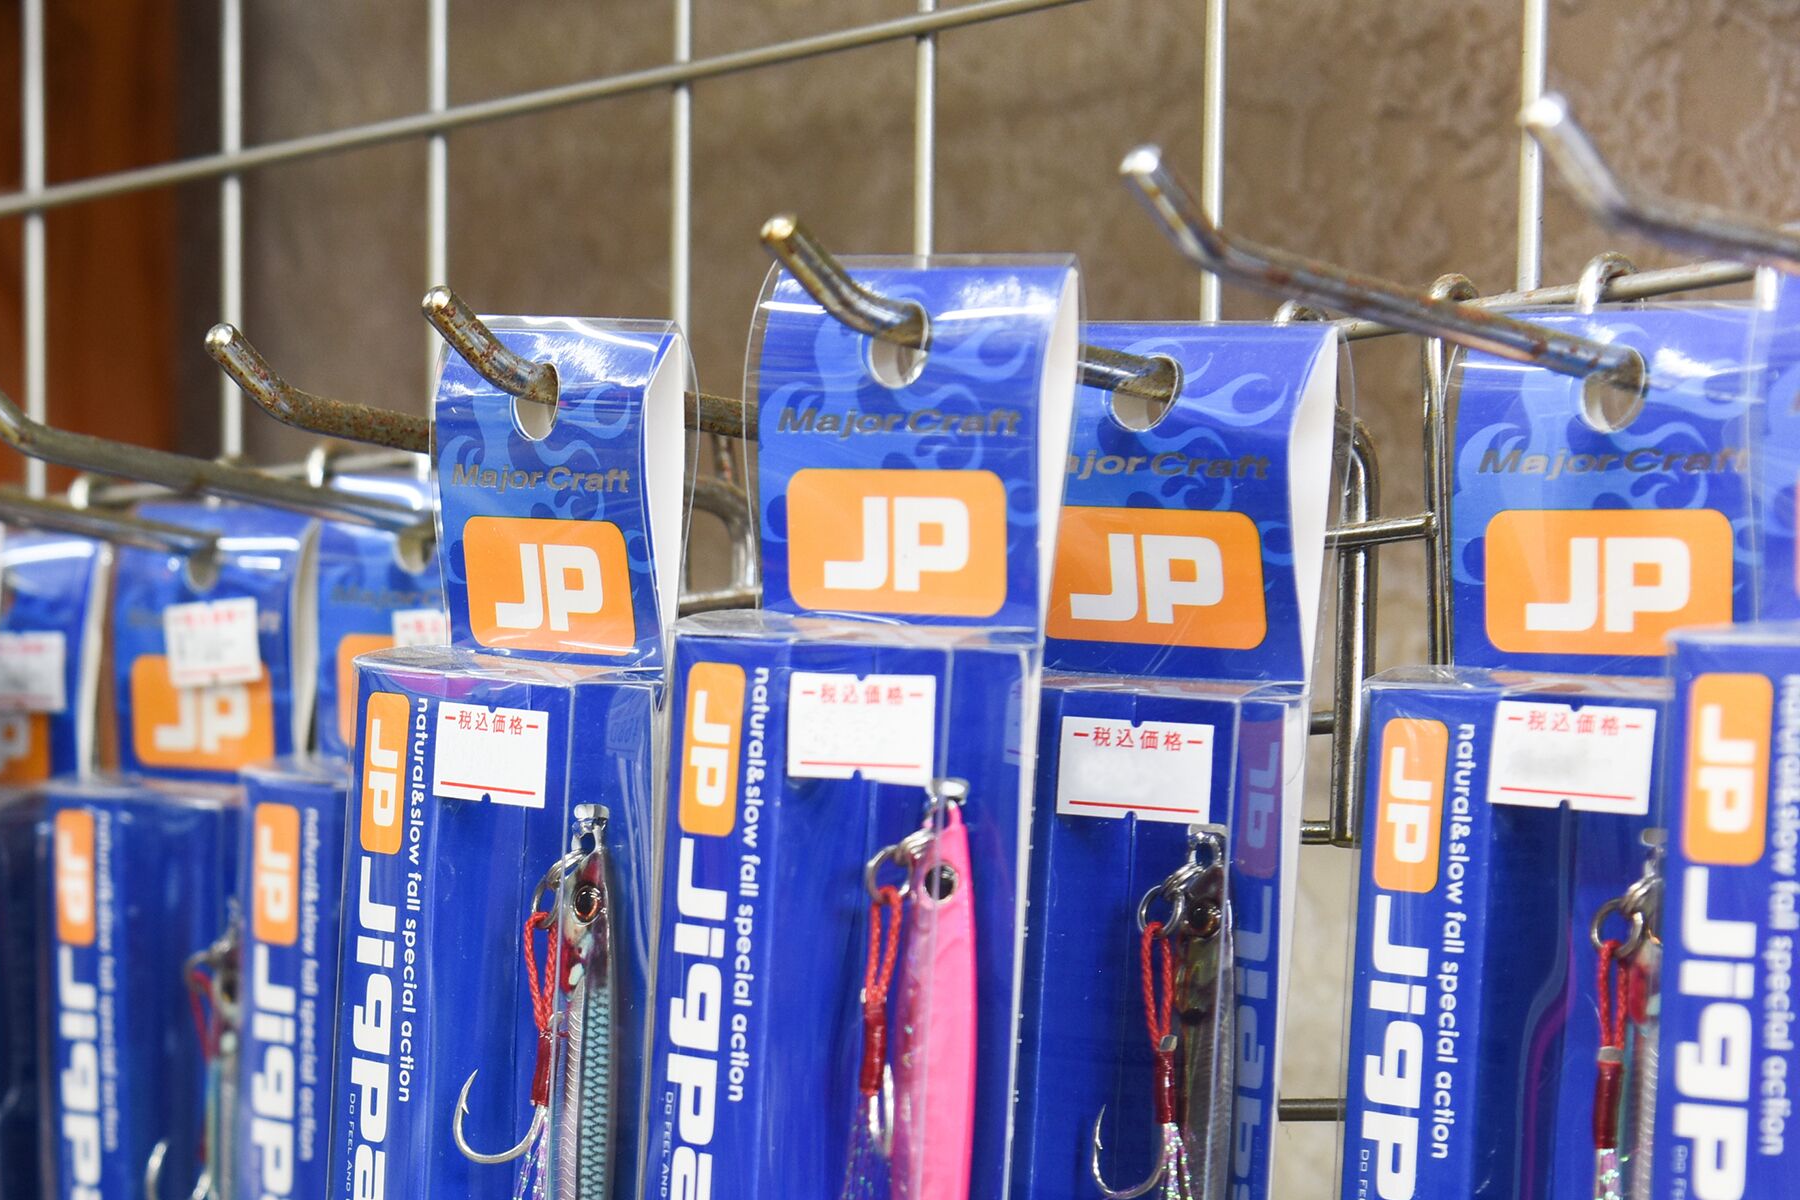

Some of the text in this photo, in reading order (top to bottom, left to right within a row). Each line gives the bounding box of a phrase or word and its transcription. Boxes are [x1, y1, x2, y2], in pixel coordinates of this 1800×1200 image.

[778, 406, 1022, 439] Major Craft
[1150, 451, 1272, 480] Craft
[1478, 446, 1748, 477] Major Craft
[451, 461, 630, 495] Major Craft
[495, 542, 604, 632] JP
[822, 497, 971, 592] JP
[1069, 533, 1224, 624] JP
[1525, 537, 1691, 633] JP
[154, 682, 251, 752] JP
[458, 710, 524, 736] 税込価格
[690, 690, 731, 808] JP
[1092, 726, 1182, 752] 税込価格
[368, 719, 399, 827] JP
[1387, 746, 1433, 863] JP
[1697, 704, 1758, 833] JP
[260, 825, 291, 922] JP
[398, 697, 428, 1102] natural&slow fall special action
[728, 667, 770, 1102] natural&slow fall special action
[1431, 723, 1476, 1159] natural&slow fall special action
[1762, 936, 1797, 1051] special
[1758, 1055, 1792, 1156] action
